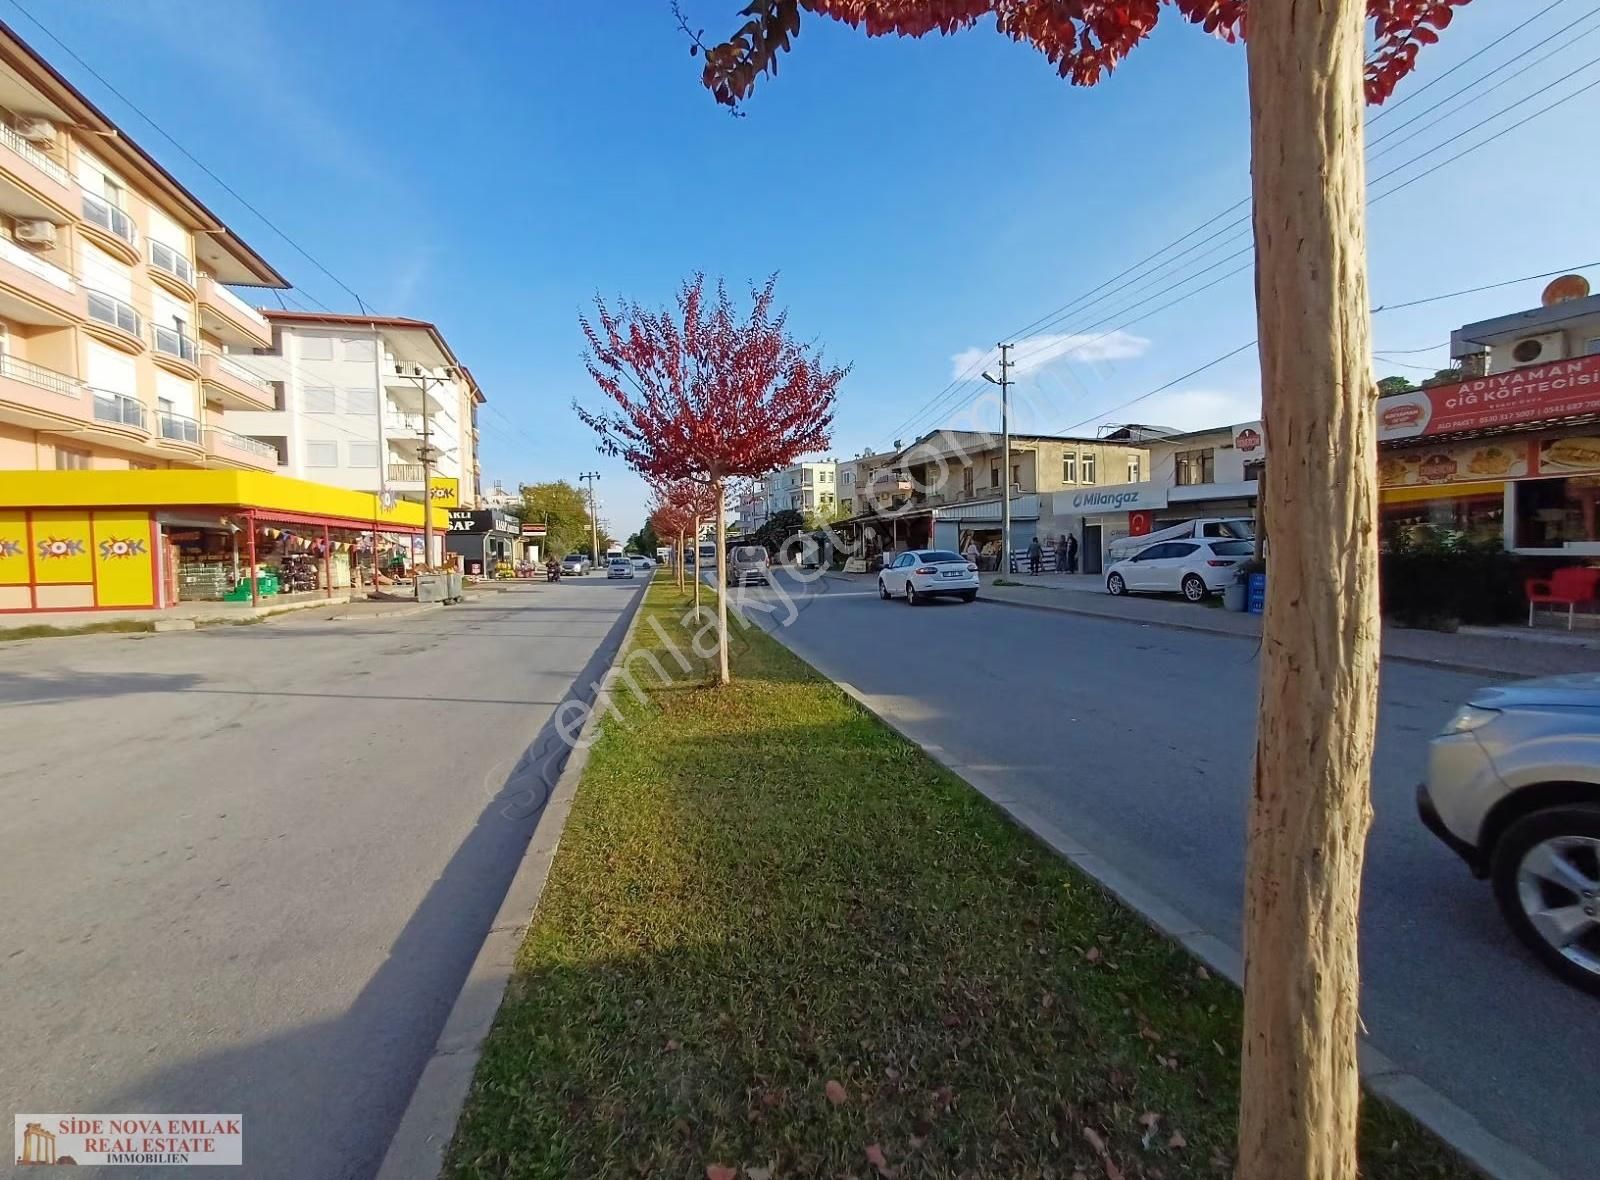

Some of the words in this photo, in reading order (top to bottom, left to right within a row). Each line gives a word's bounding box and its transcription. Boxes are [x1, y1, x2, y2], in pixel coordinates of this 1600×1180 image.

[1458, 362, 1583, 394] ADIYAMAN
[1483, 369, 1600, 401] KÖFTECİSİ
[1083, 490, 1139, 509] Milangaz
